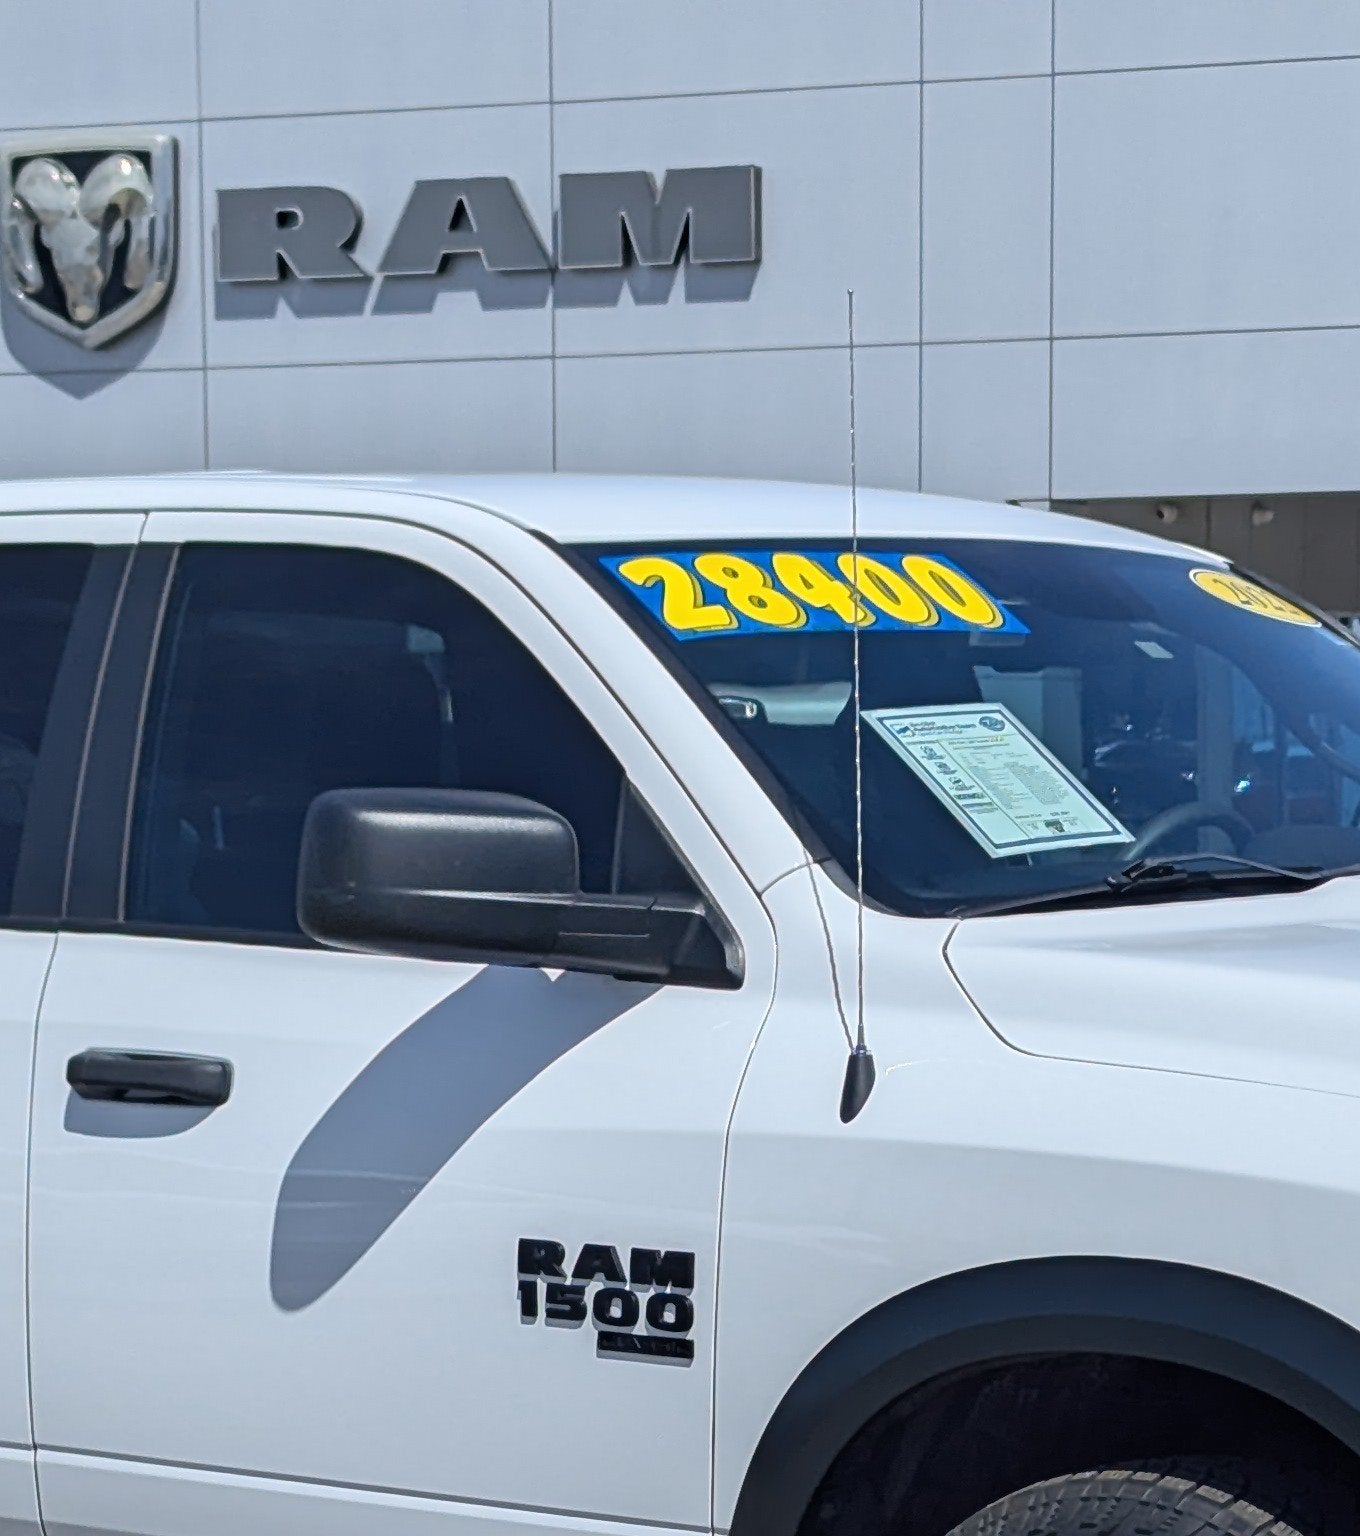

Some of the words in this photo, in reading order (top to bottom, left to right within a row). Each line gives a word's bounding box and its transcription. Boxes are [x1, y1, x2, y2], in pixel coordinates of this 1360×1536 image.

[214, 164, 762, 284] RAM
[618, 552, 1004, 629] 28400
[517, 1237, 695, 1289] RAM
[517, 1280, 694, 1333] 1500
